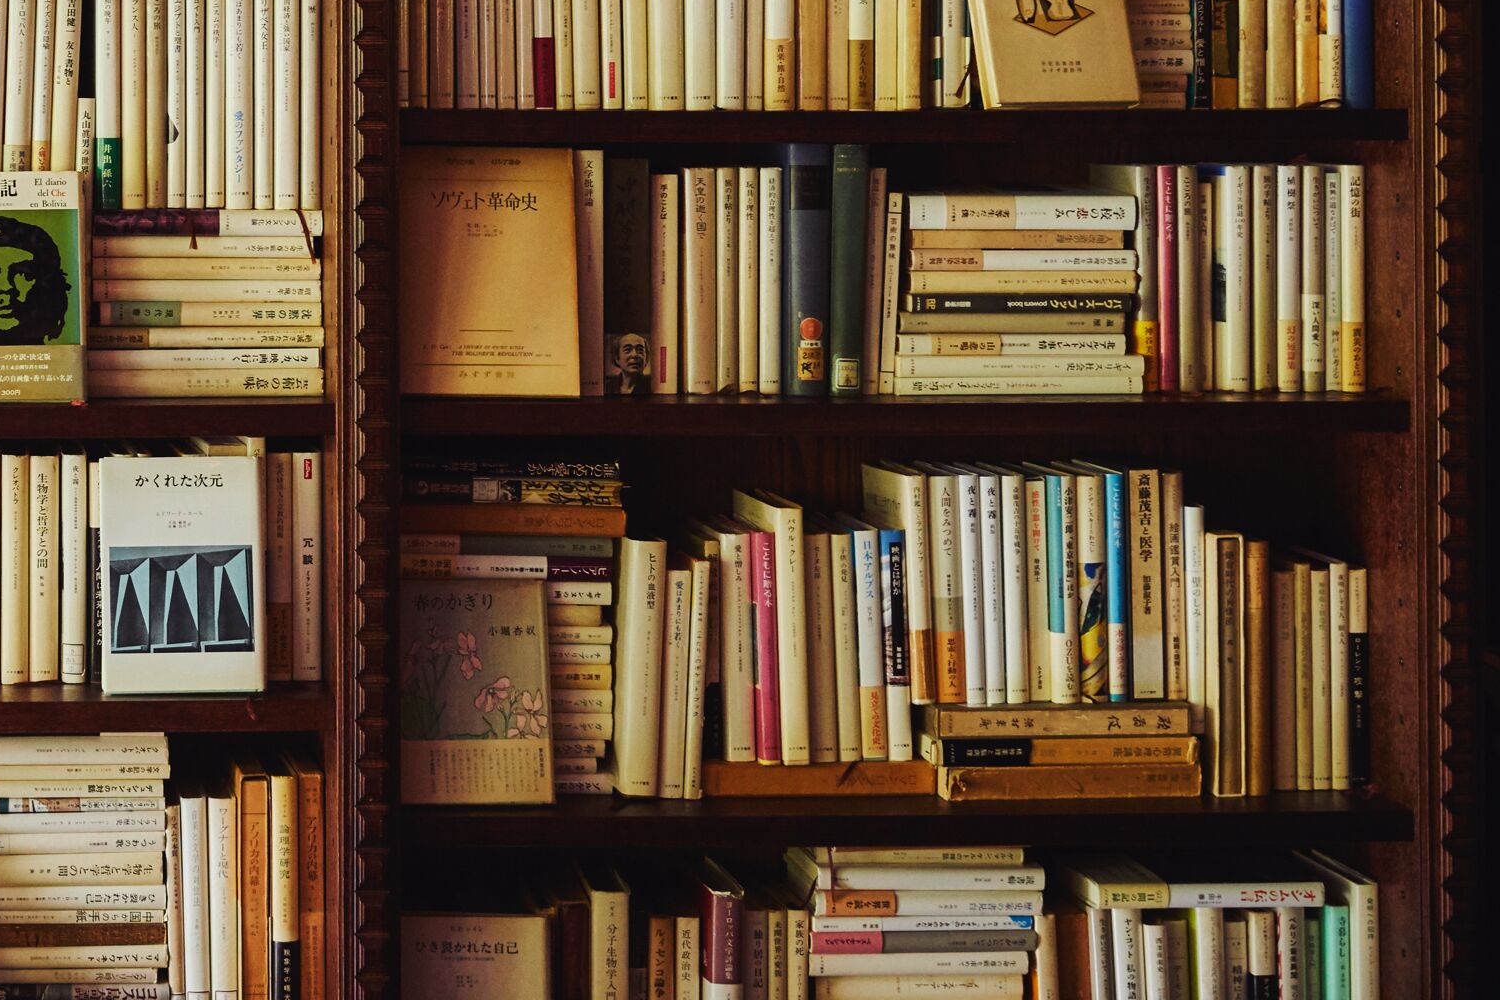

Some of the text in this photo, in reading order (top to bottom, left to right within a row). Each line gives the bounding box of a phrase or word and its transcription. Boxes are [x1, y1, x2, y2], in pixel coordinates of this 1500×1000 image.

[34, 178, 66, 186] El diario
[135, 474, 224, 488] かくれた次元
